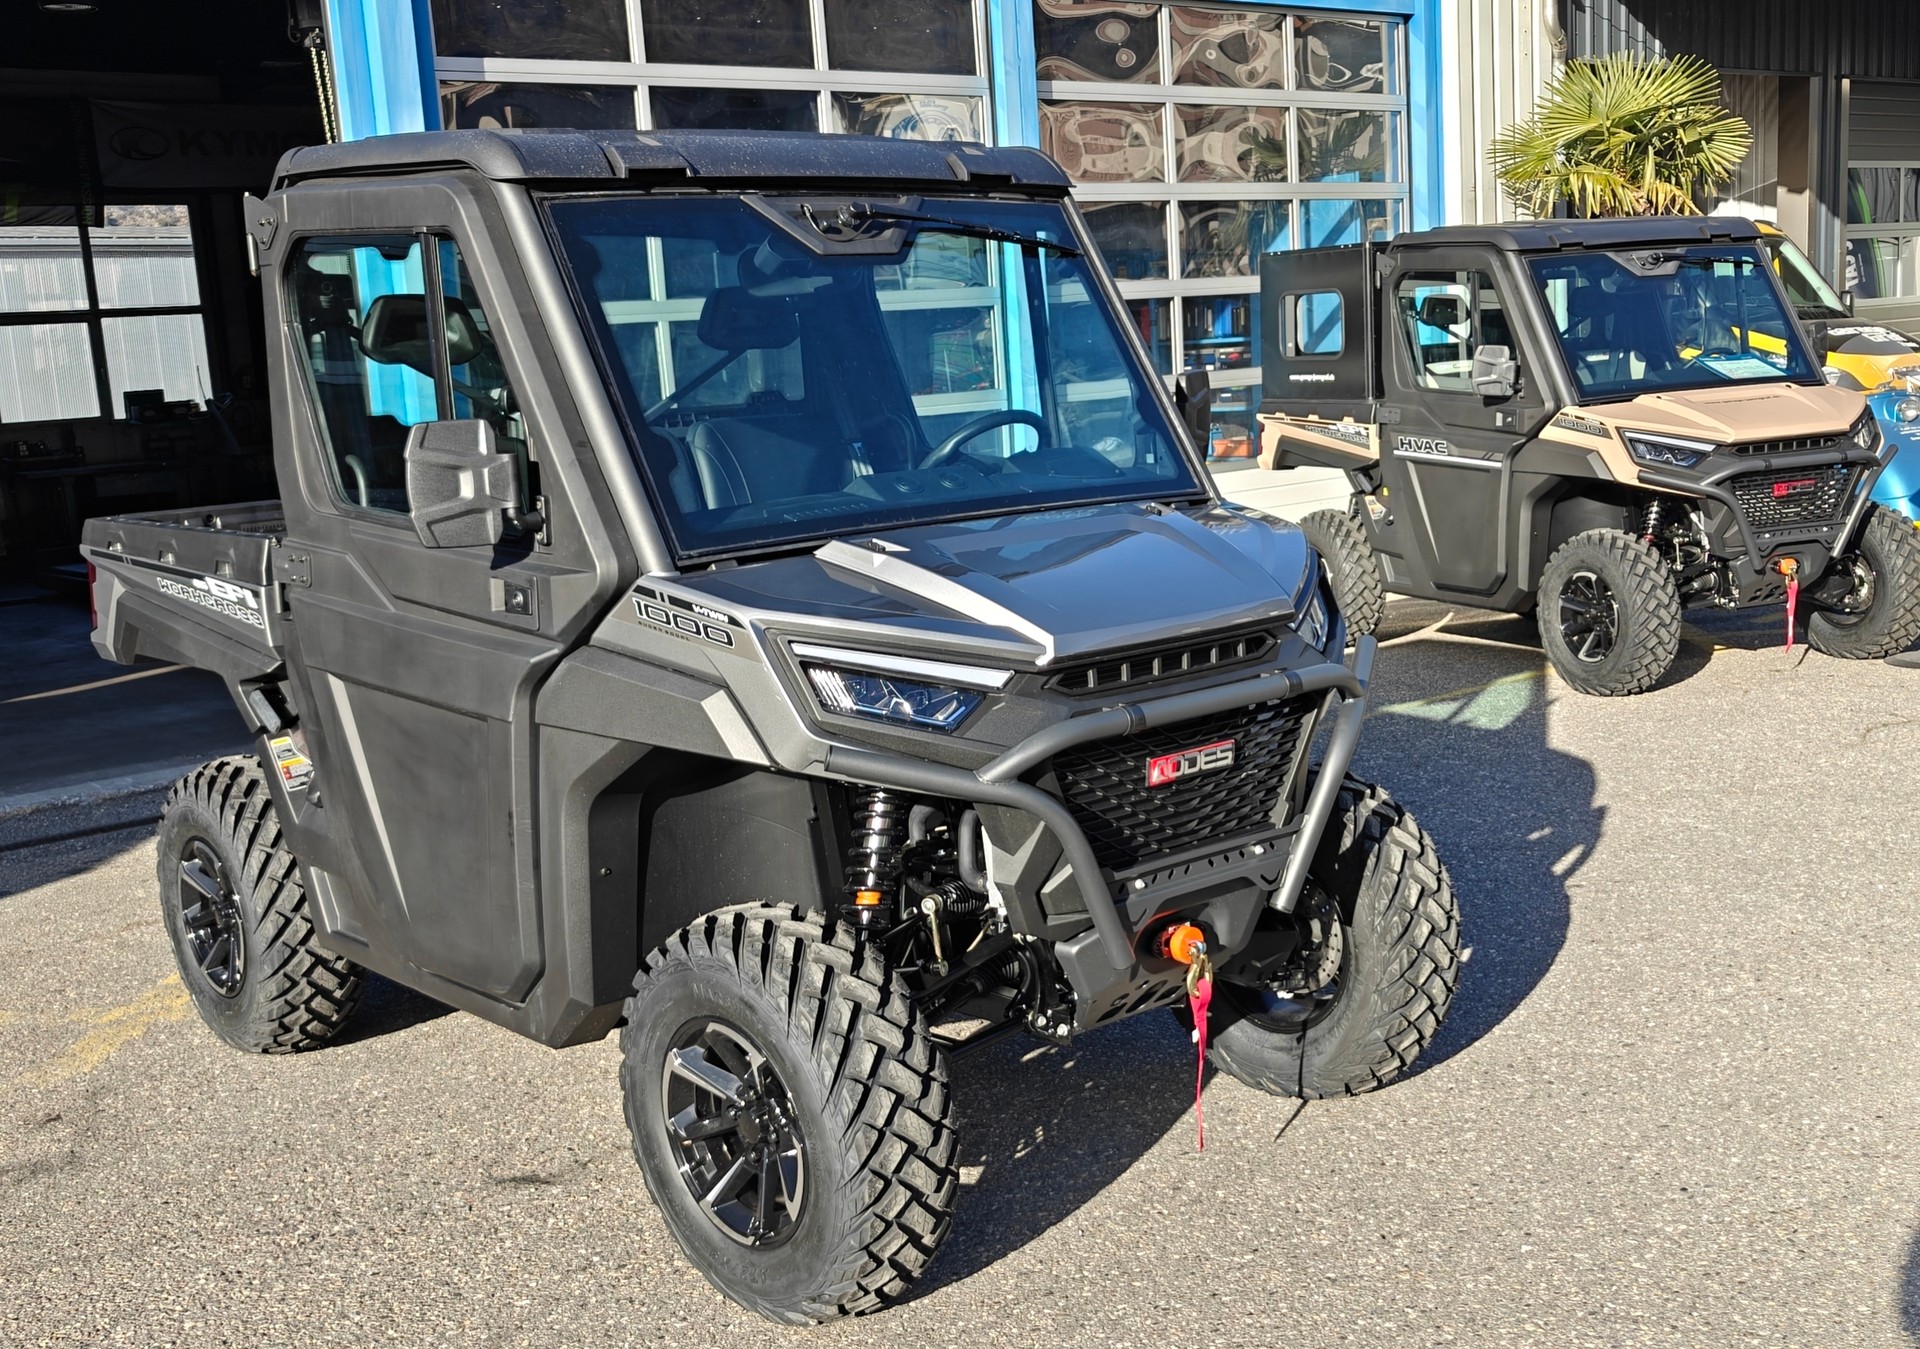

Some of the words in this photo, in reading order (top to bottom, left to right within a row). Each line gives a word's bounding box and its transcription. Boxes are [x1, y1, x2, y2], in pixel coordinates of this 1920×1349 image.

[1398, 436, 1448, 456] HVAC
[157, 577, 265, 629] WORKCROSS
[204, 576, 259, 609] EFI
[632, 597, 736, 649] 1000
